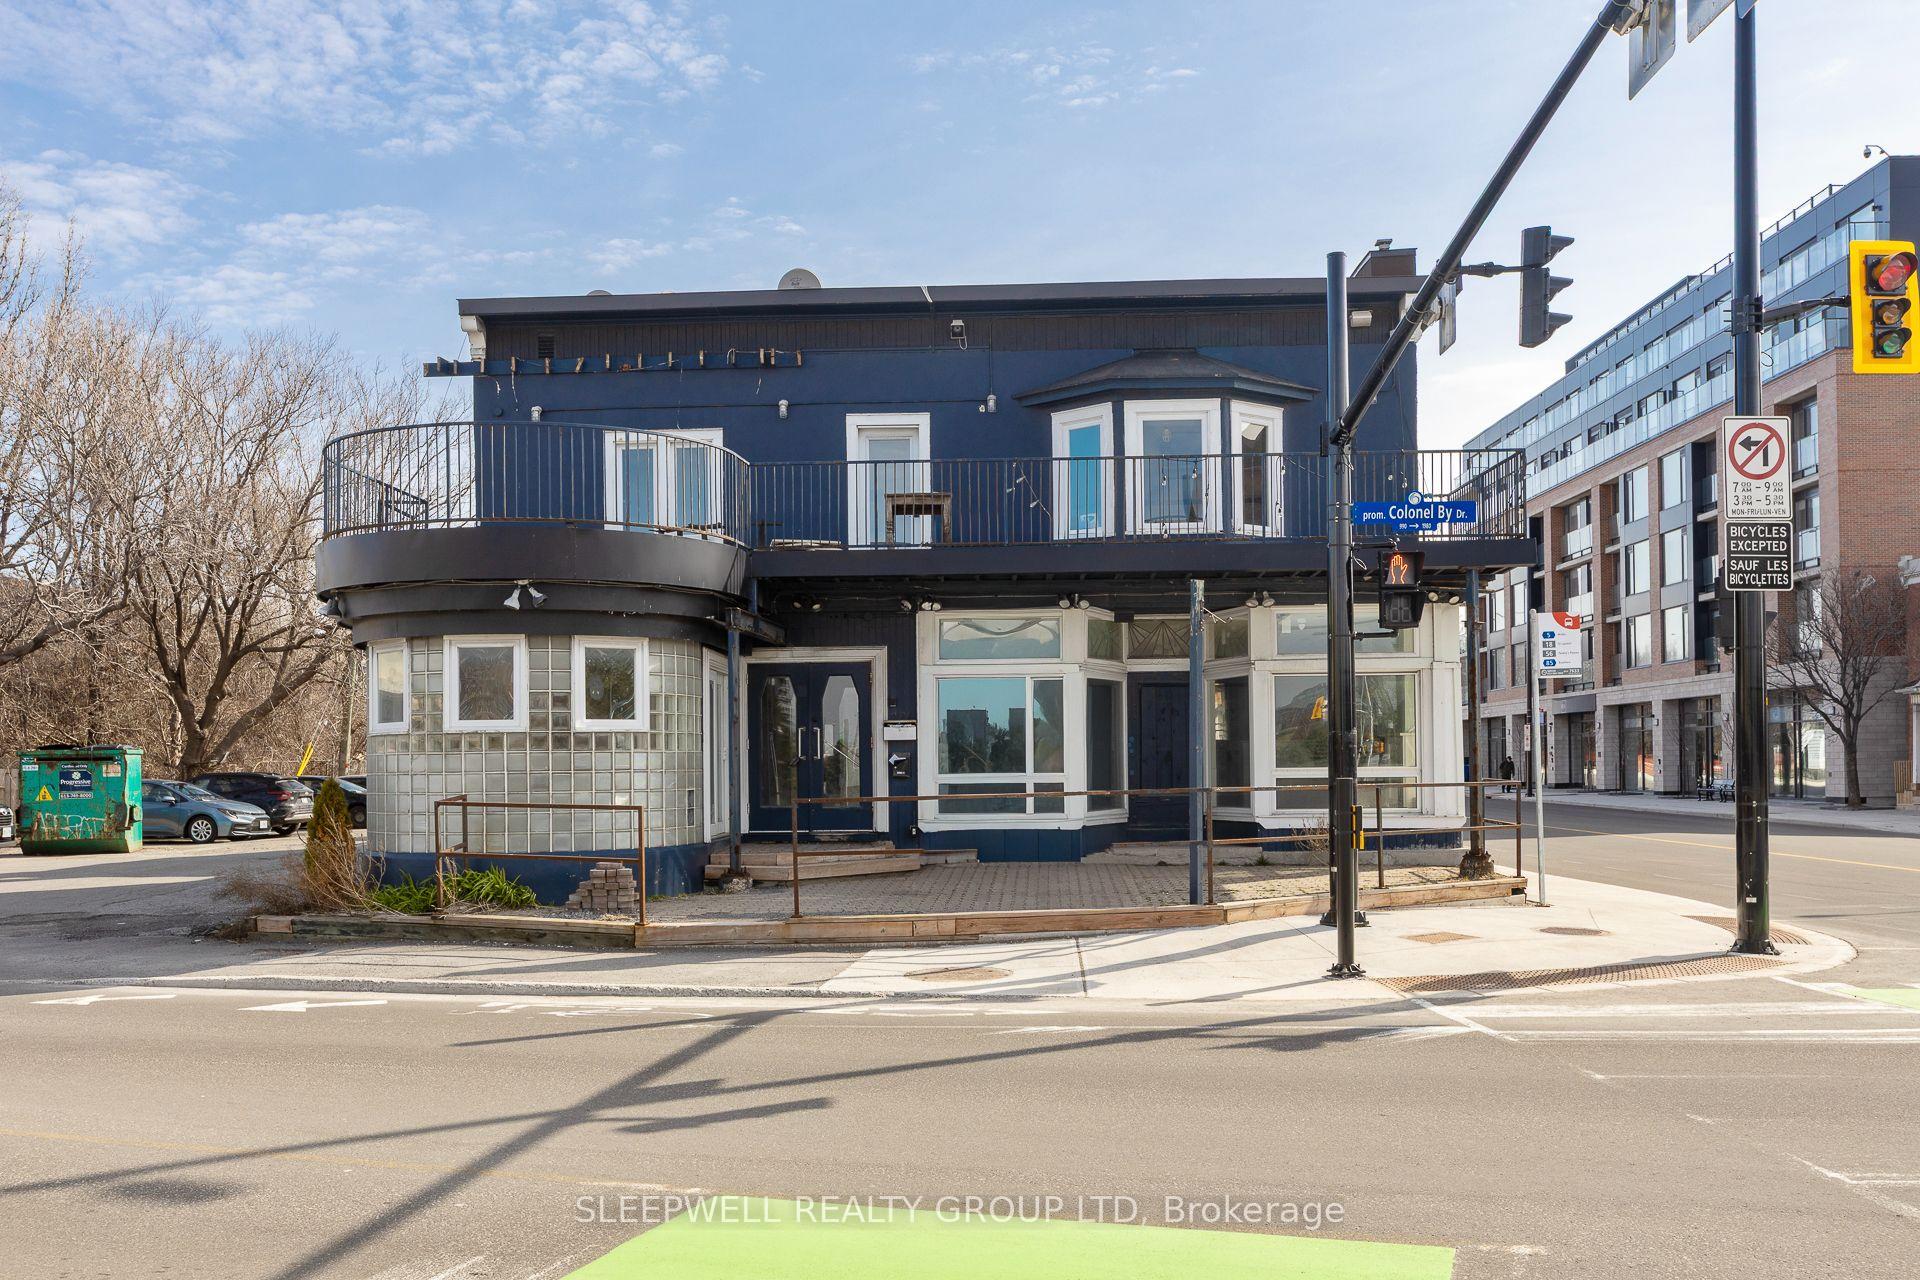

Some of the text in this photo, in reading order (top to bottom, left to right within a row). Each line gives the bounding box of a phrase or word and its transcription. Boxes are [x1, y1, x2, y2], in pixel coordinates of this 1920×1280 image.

[1732, 482, 1739, 492] 7
[1764, 482, 1770, 492] 9
[1734, 495, 1740, 506] 3
[1765, 495, 1771, 506] 5
[1363, 506, 1468, 522] prom. Colonel By Dr.
[1730, 526, 1787, 538] BICYCLES
[1730, 540, 1787, 551] EXCEPTED
[1730, 560, 1788, 570] SAUF LES
[1730, 574, 1789, 585] BICYCLETTES
